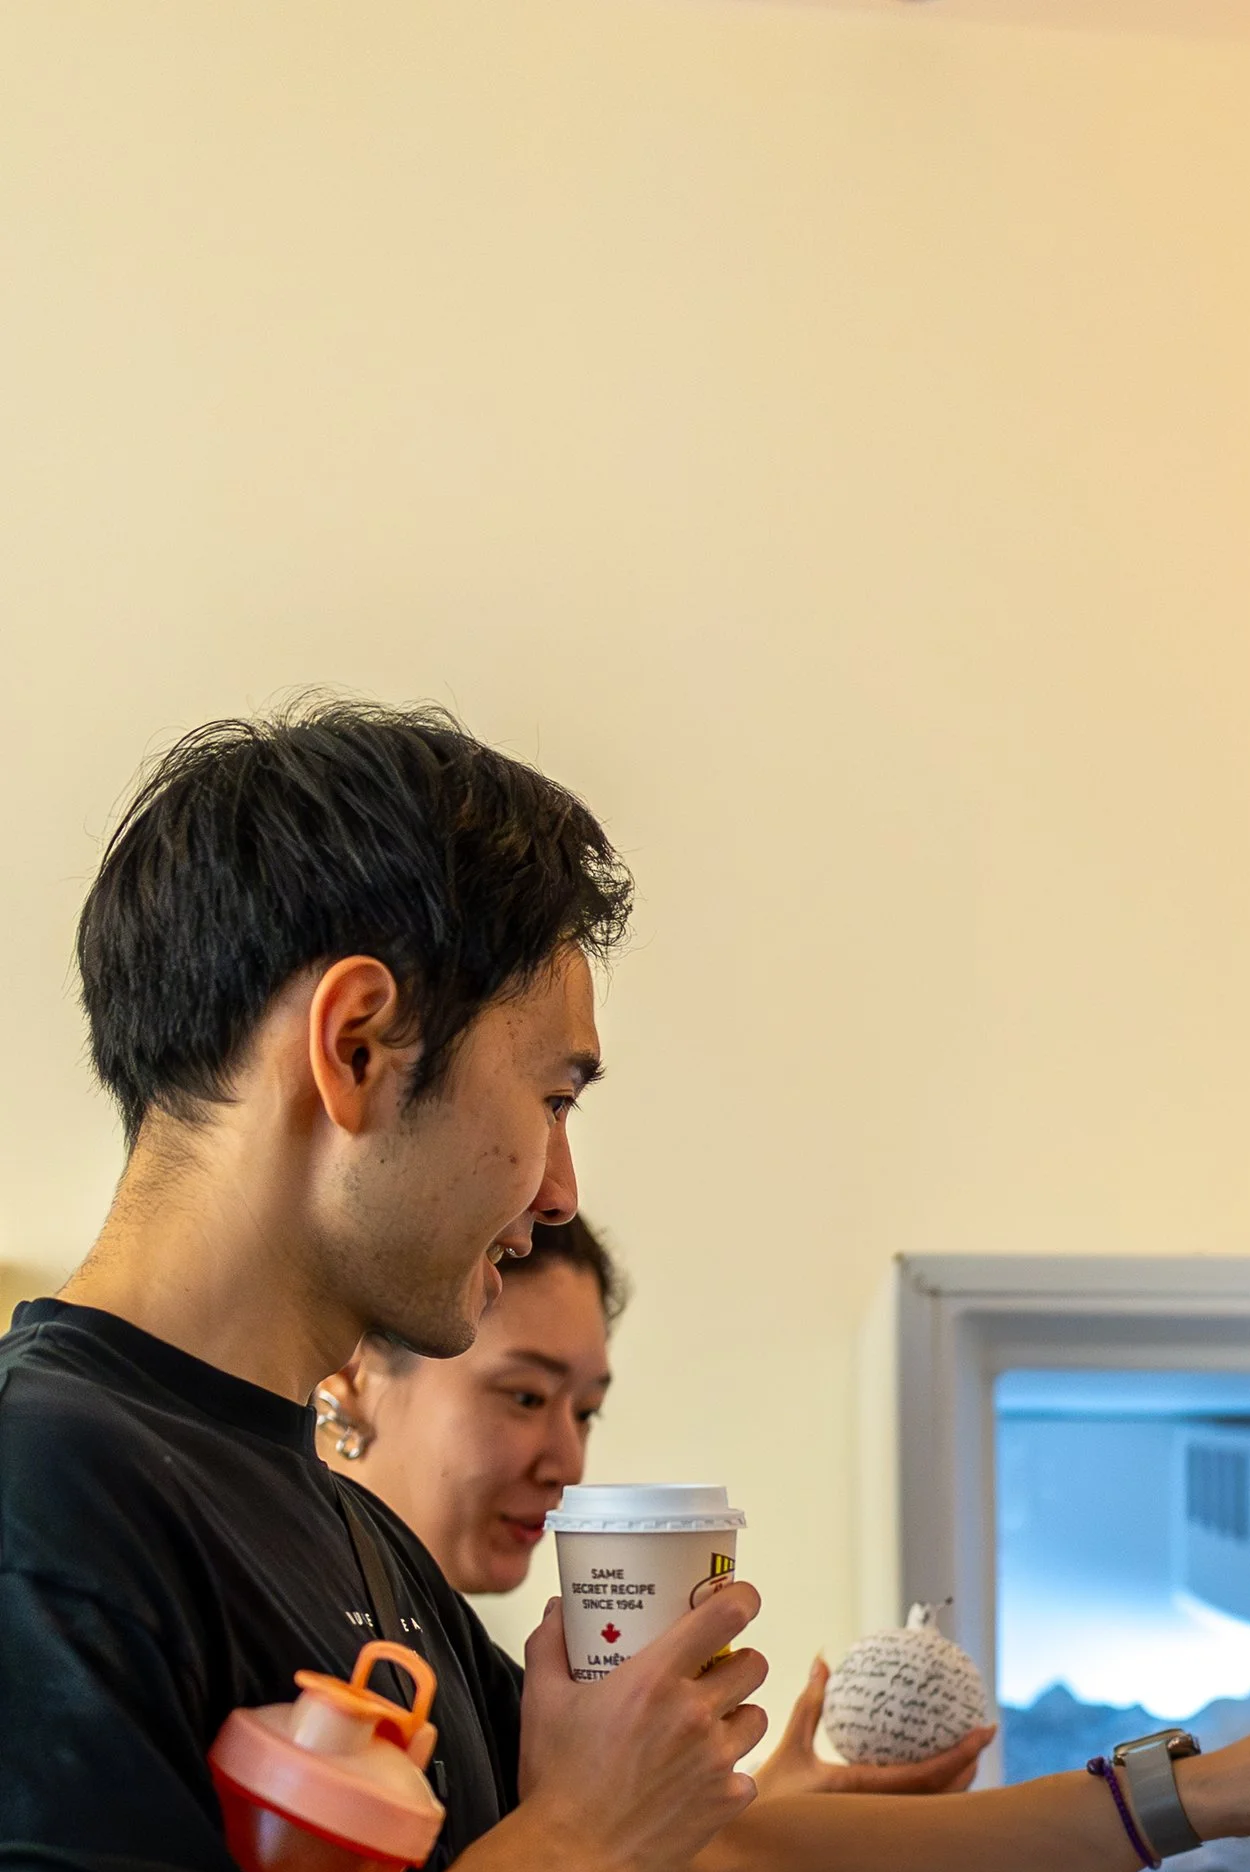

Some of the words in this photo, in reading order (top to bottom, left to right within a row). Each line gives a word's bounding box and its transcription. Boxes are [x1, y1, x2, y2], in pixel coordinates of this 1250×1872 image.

[591, 1568, 624, 1580] SAME
[572, 1582, 608, 1595] SECRET
[611, 1583, 656, 1595] RECIPE
[582, 1598, 614, 1610] SINCE
[616, 1599, 643, 1610] 1964
[587, 1654, 601, 1665] LA
